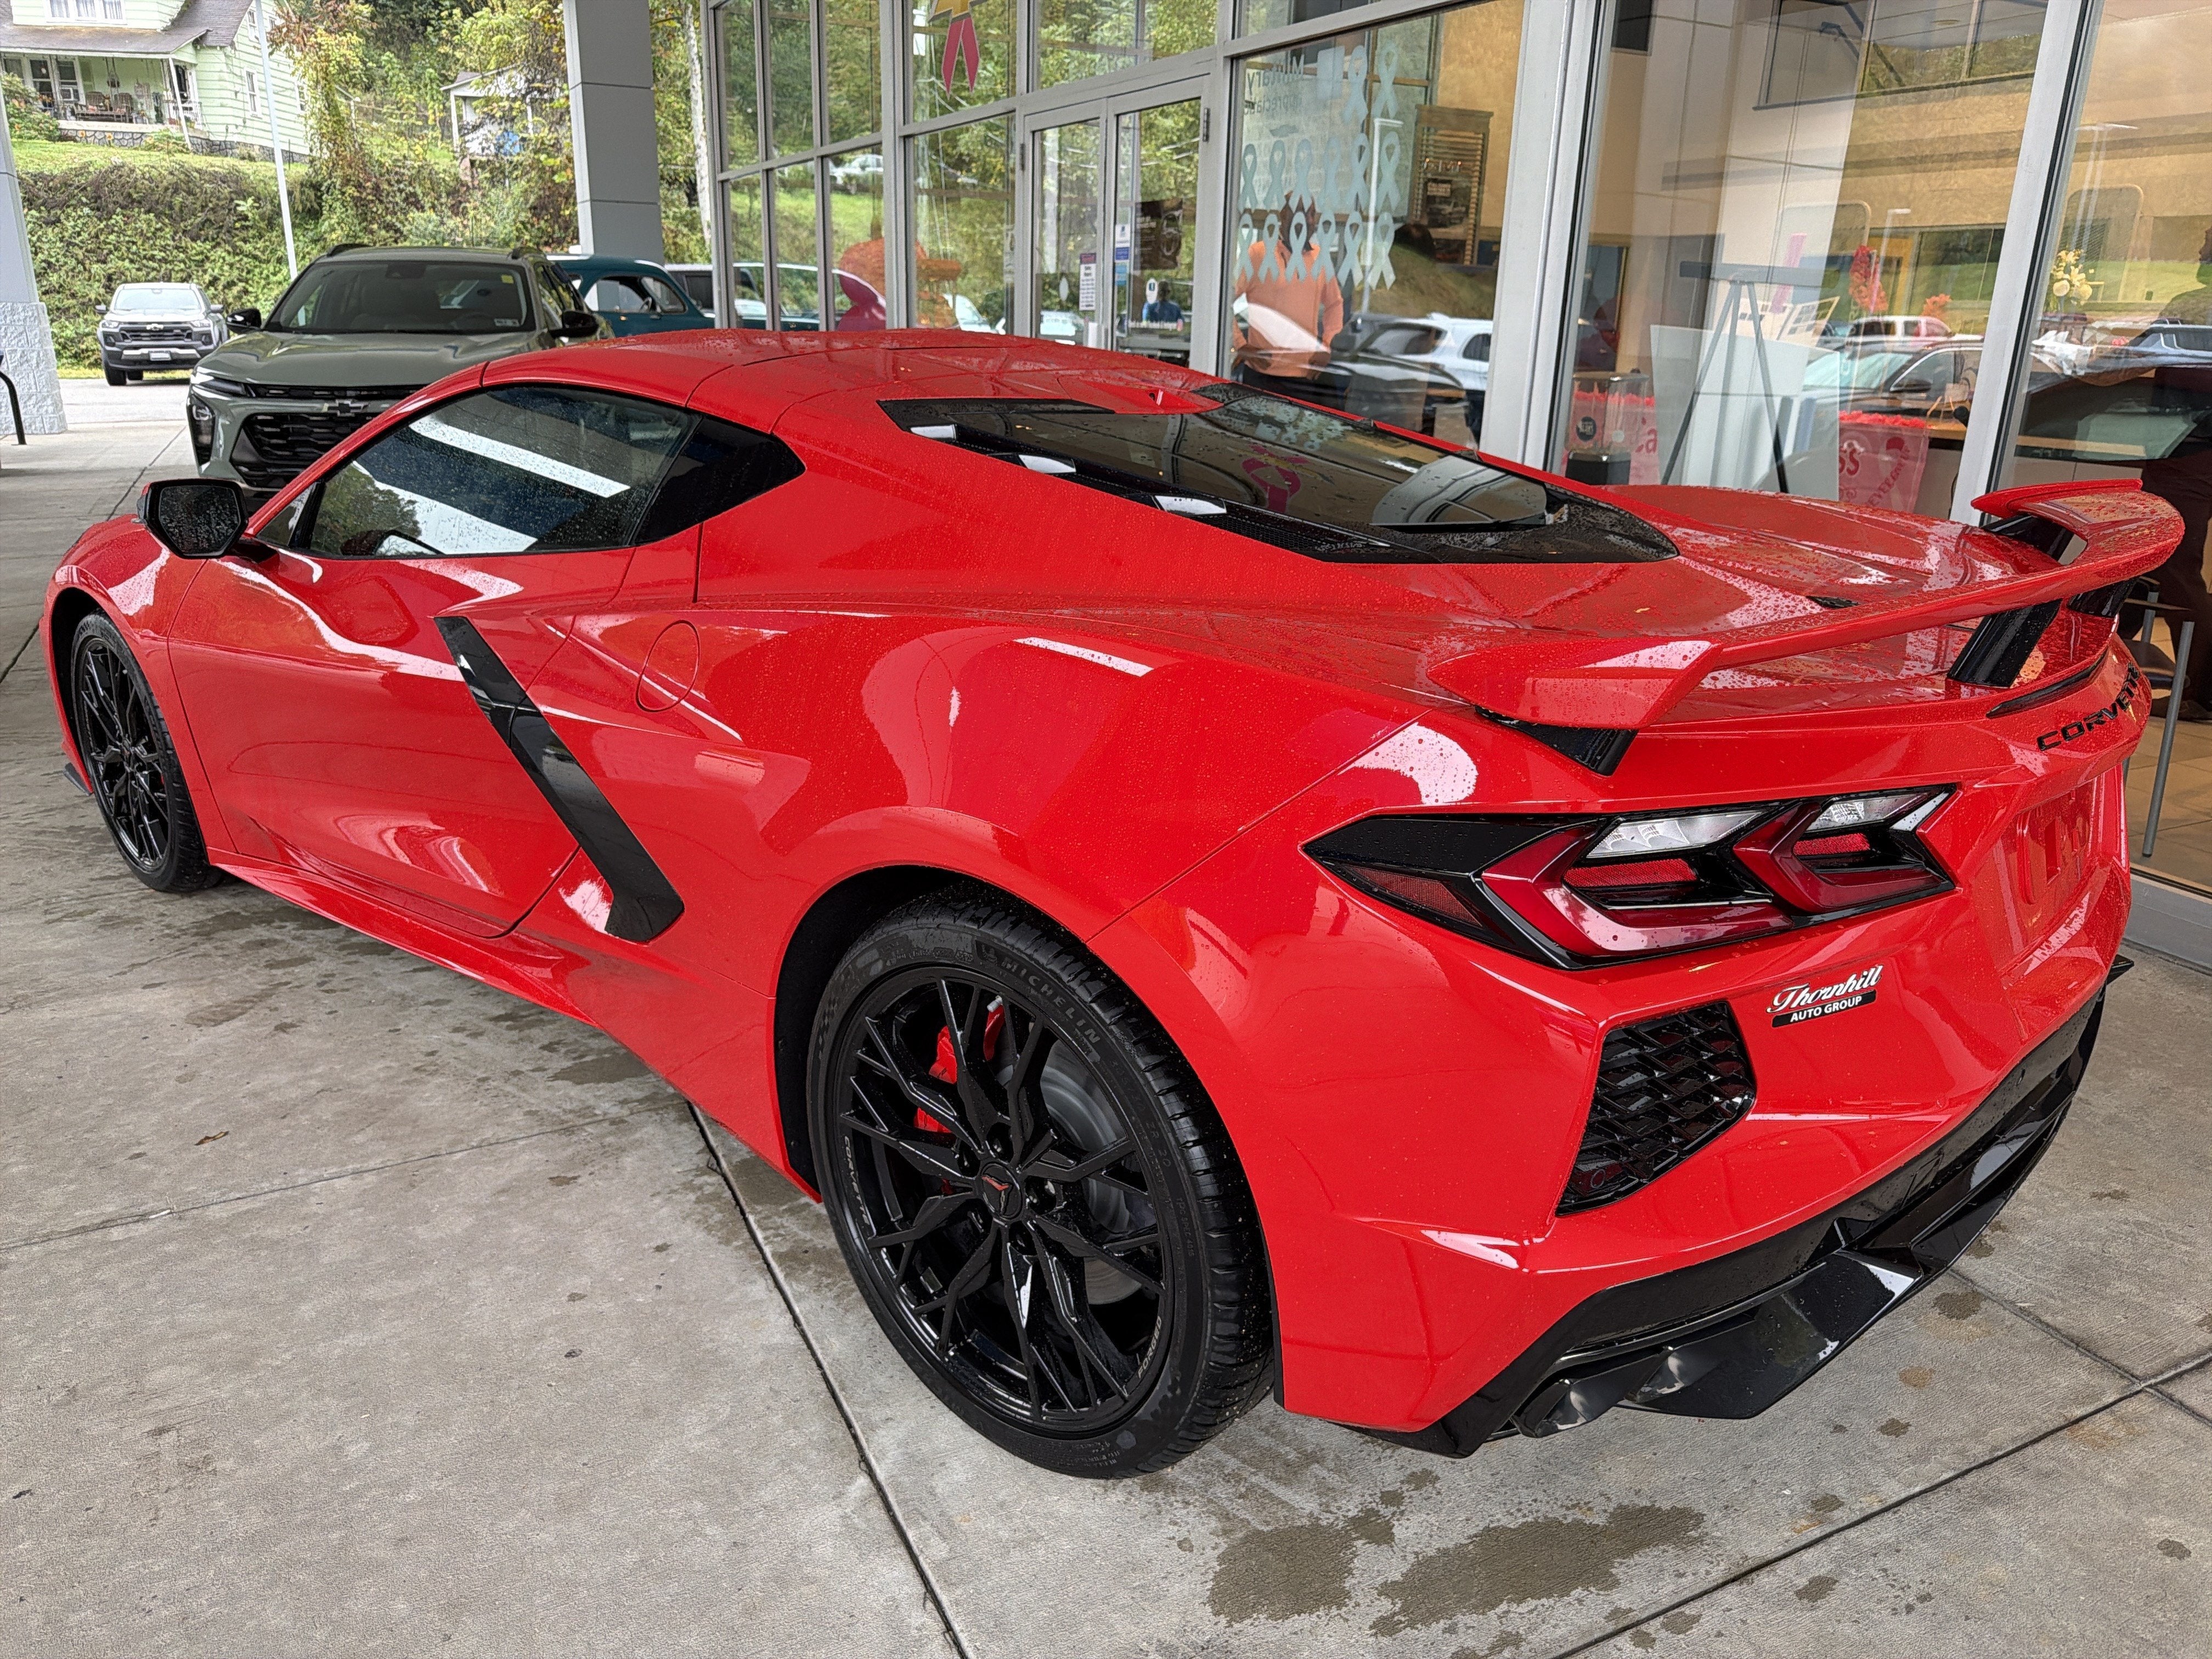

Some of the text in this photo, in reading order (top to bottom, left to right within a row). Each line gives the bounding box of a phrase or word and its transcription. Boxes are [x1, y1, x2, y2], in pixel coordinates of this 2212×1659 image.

[2036, 662, 2139, 752] CORVETTE
[1001, 957, 1101, 1043] MICHELIN
[1765, 964, 1883, 1013] Thornhill
[1790, 995, 1862, 1023] AUTO GROUP
[844, 1135, 871, 1226] CORVETTE
[1159, 1149, 1171, 1167] 20
[1137, 1315, 1162, 1379] FORGED
